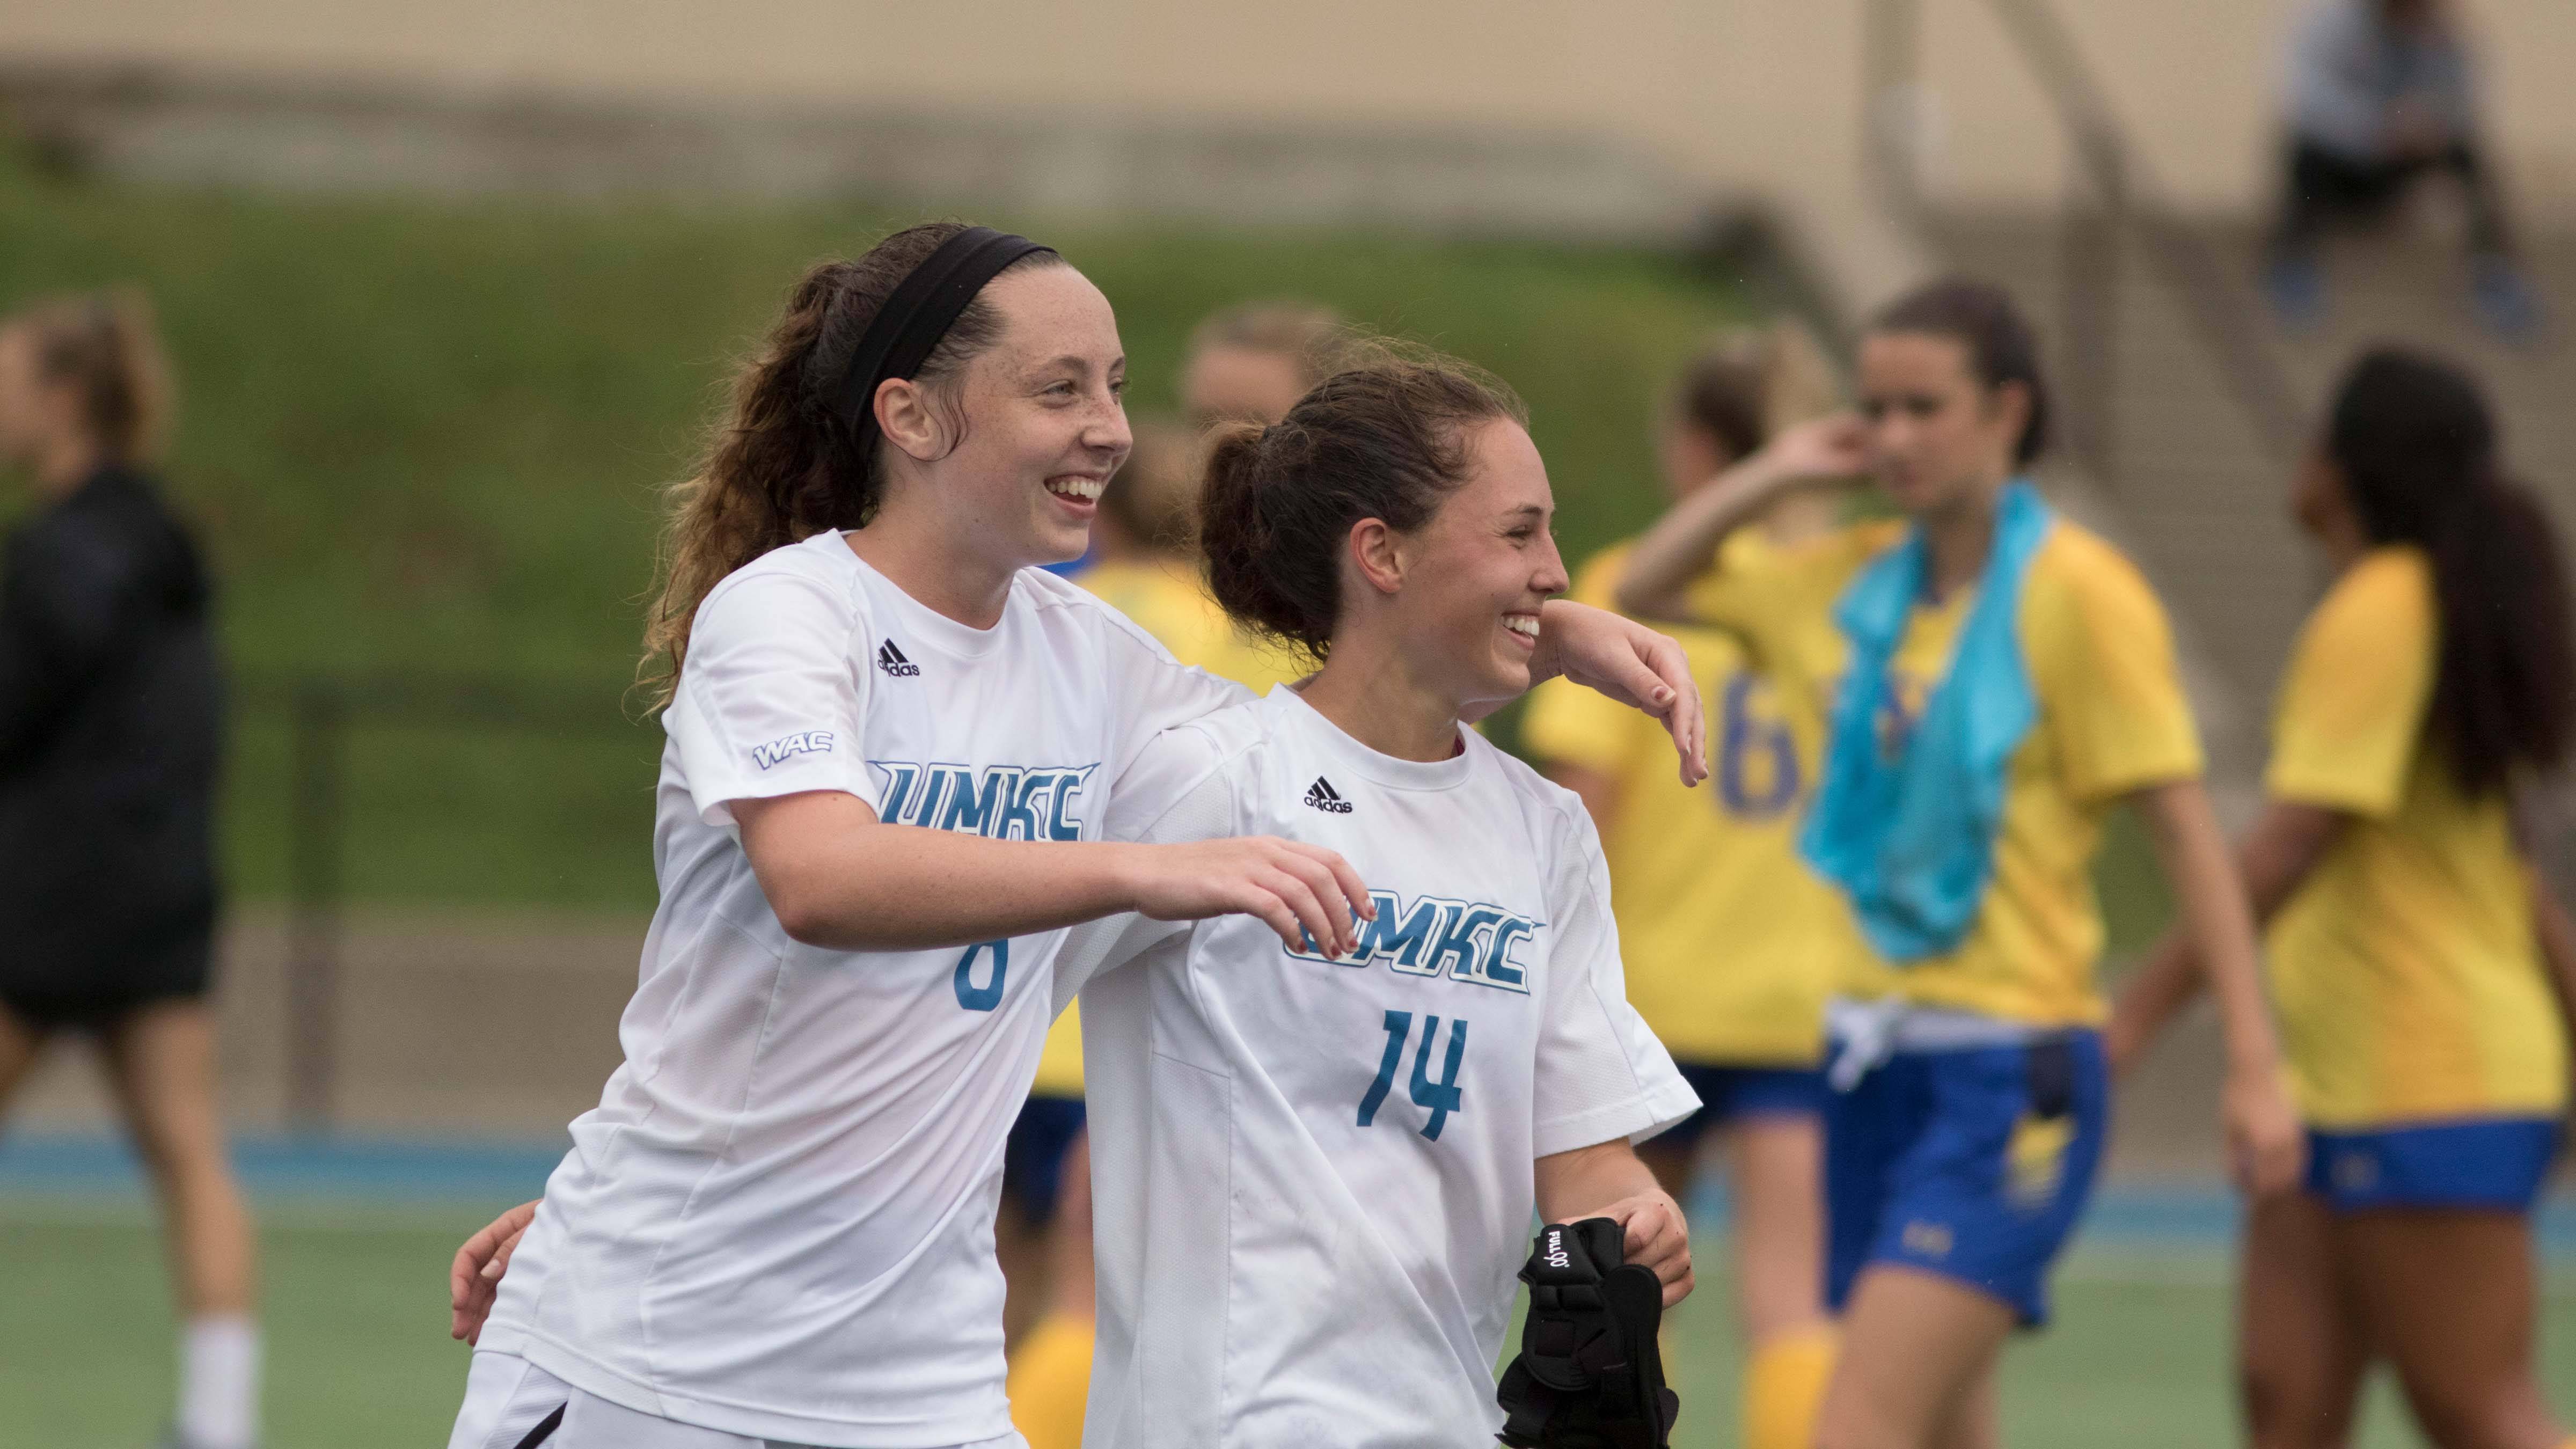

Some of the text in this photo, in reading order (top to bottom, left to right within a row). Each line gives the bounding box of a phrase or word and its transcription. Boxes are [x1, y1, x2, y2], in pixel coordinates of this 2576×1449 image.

[753, 731, 833, 770] WAC
[866, 760, 1101, 841] UMKC
[1356, 1010, 1468, 1141] 14
